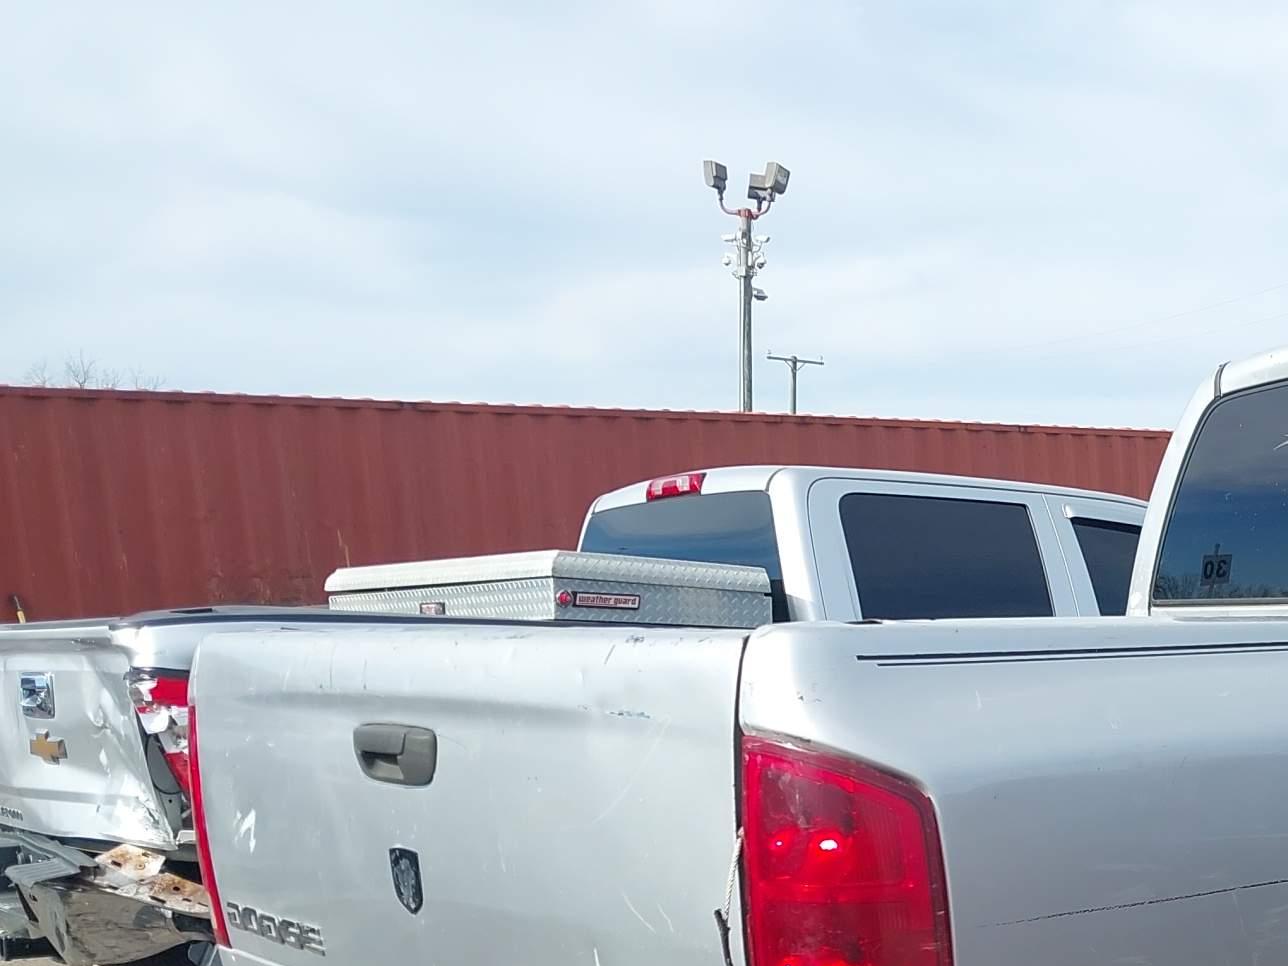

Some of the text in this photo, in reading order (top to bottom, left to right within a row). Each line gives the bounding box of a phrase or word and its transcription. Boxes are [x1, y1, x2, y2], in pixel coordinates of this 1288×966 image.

[578, 594, 637, 606] weather guard
[226, 901, 326, 957] DODGE
